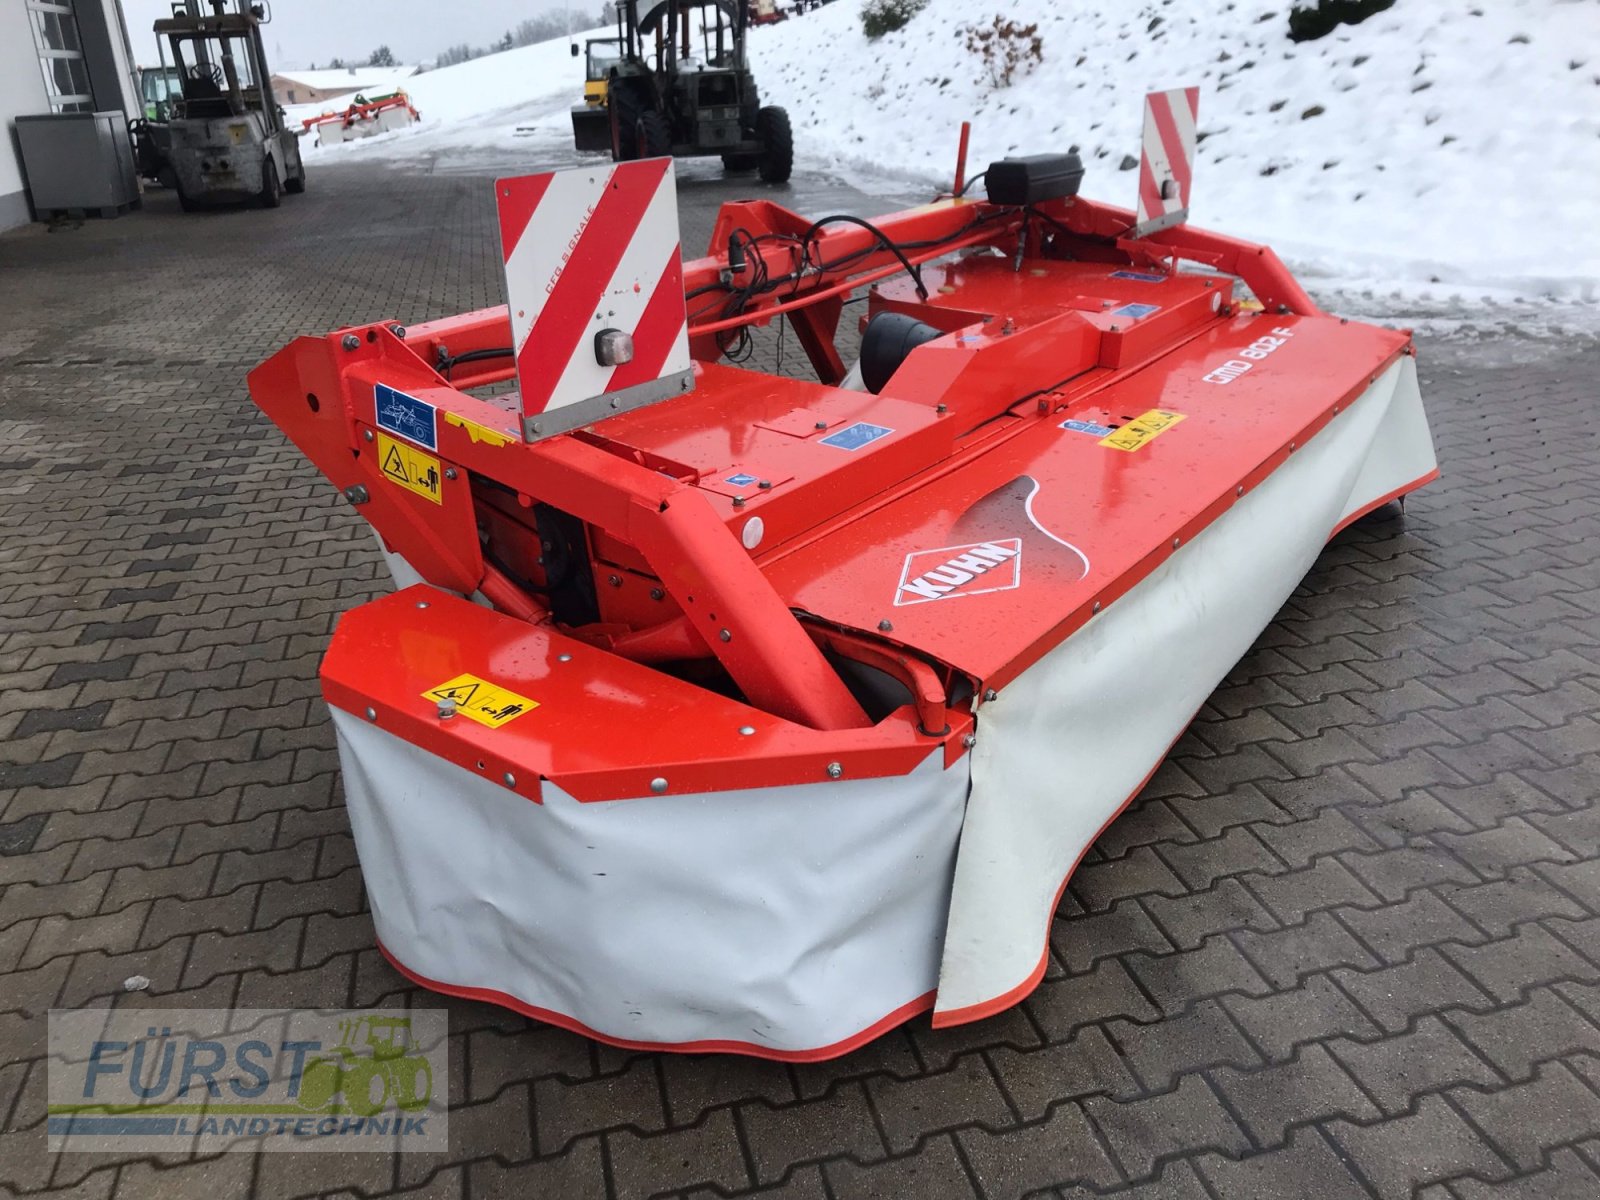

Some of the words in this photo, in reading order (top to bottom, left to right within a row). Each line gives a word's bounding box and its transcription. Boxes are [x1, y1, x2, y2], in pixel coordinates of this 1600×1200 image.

[545, 266, 563, 294] CFG
[1202, 360, 1253, 385] GMD
[1239, 335, 1288, 360] 802
[1271, 327, 1295, 337] F
[899, 542, 1020, 600] KUHN
